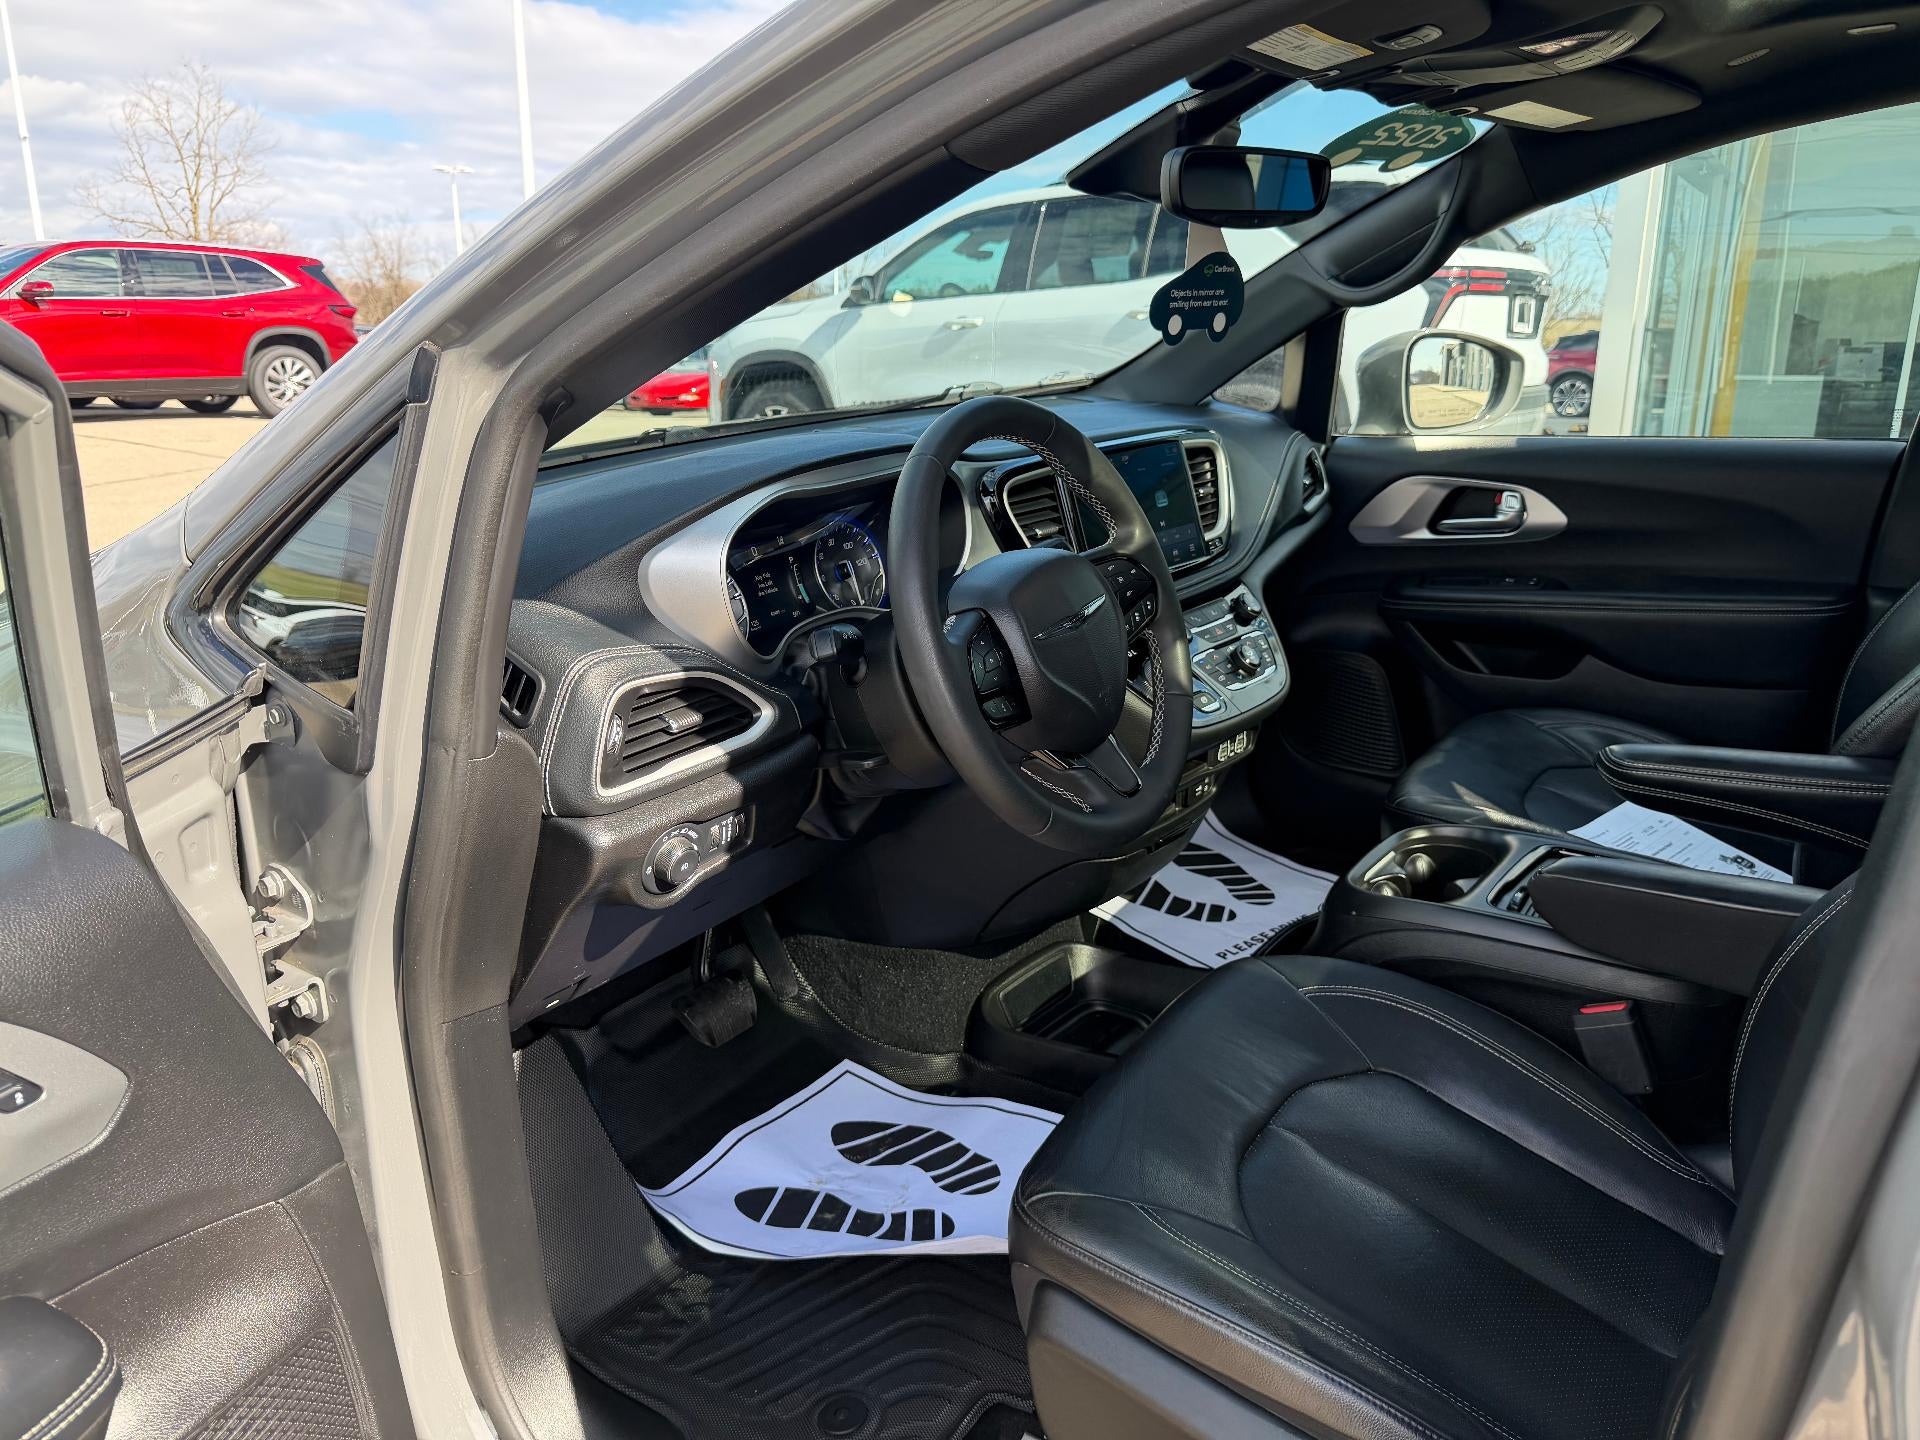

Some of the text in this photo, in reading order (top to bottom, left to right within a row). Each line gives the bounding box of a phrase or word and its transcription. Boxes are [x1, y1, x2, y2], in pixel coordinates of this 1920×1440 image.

[1170, 289, 1192, 299] Objects
[1198, 288, 1215, 296] mirror
[1169, 300, 1189, 310] smiling
[1190, 299, 1203, 308] from
[1215, 931, 1270, 960] PLEASE
